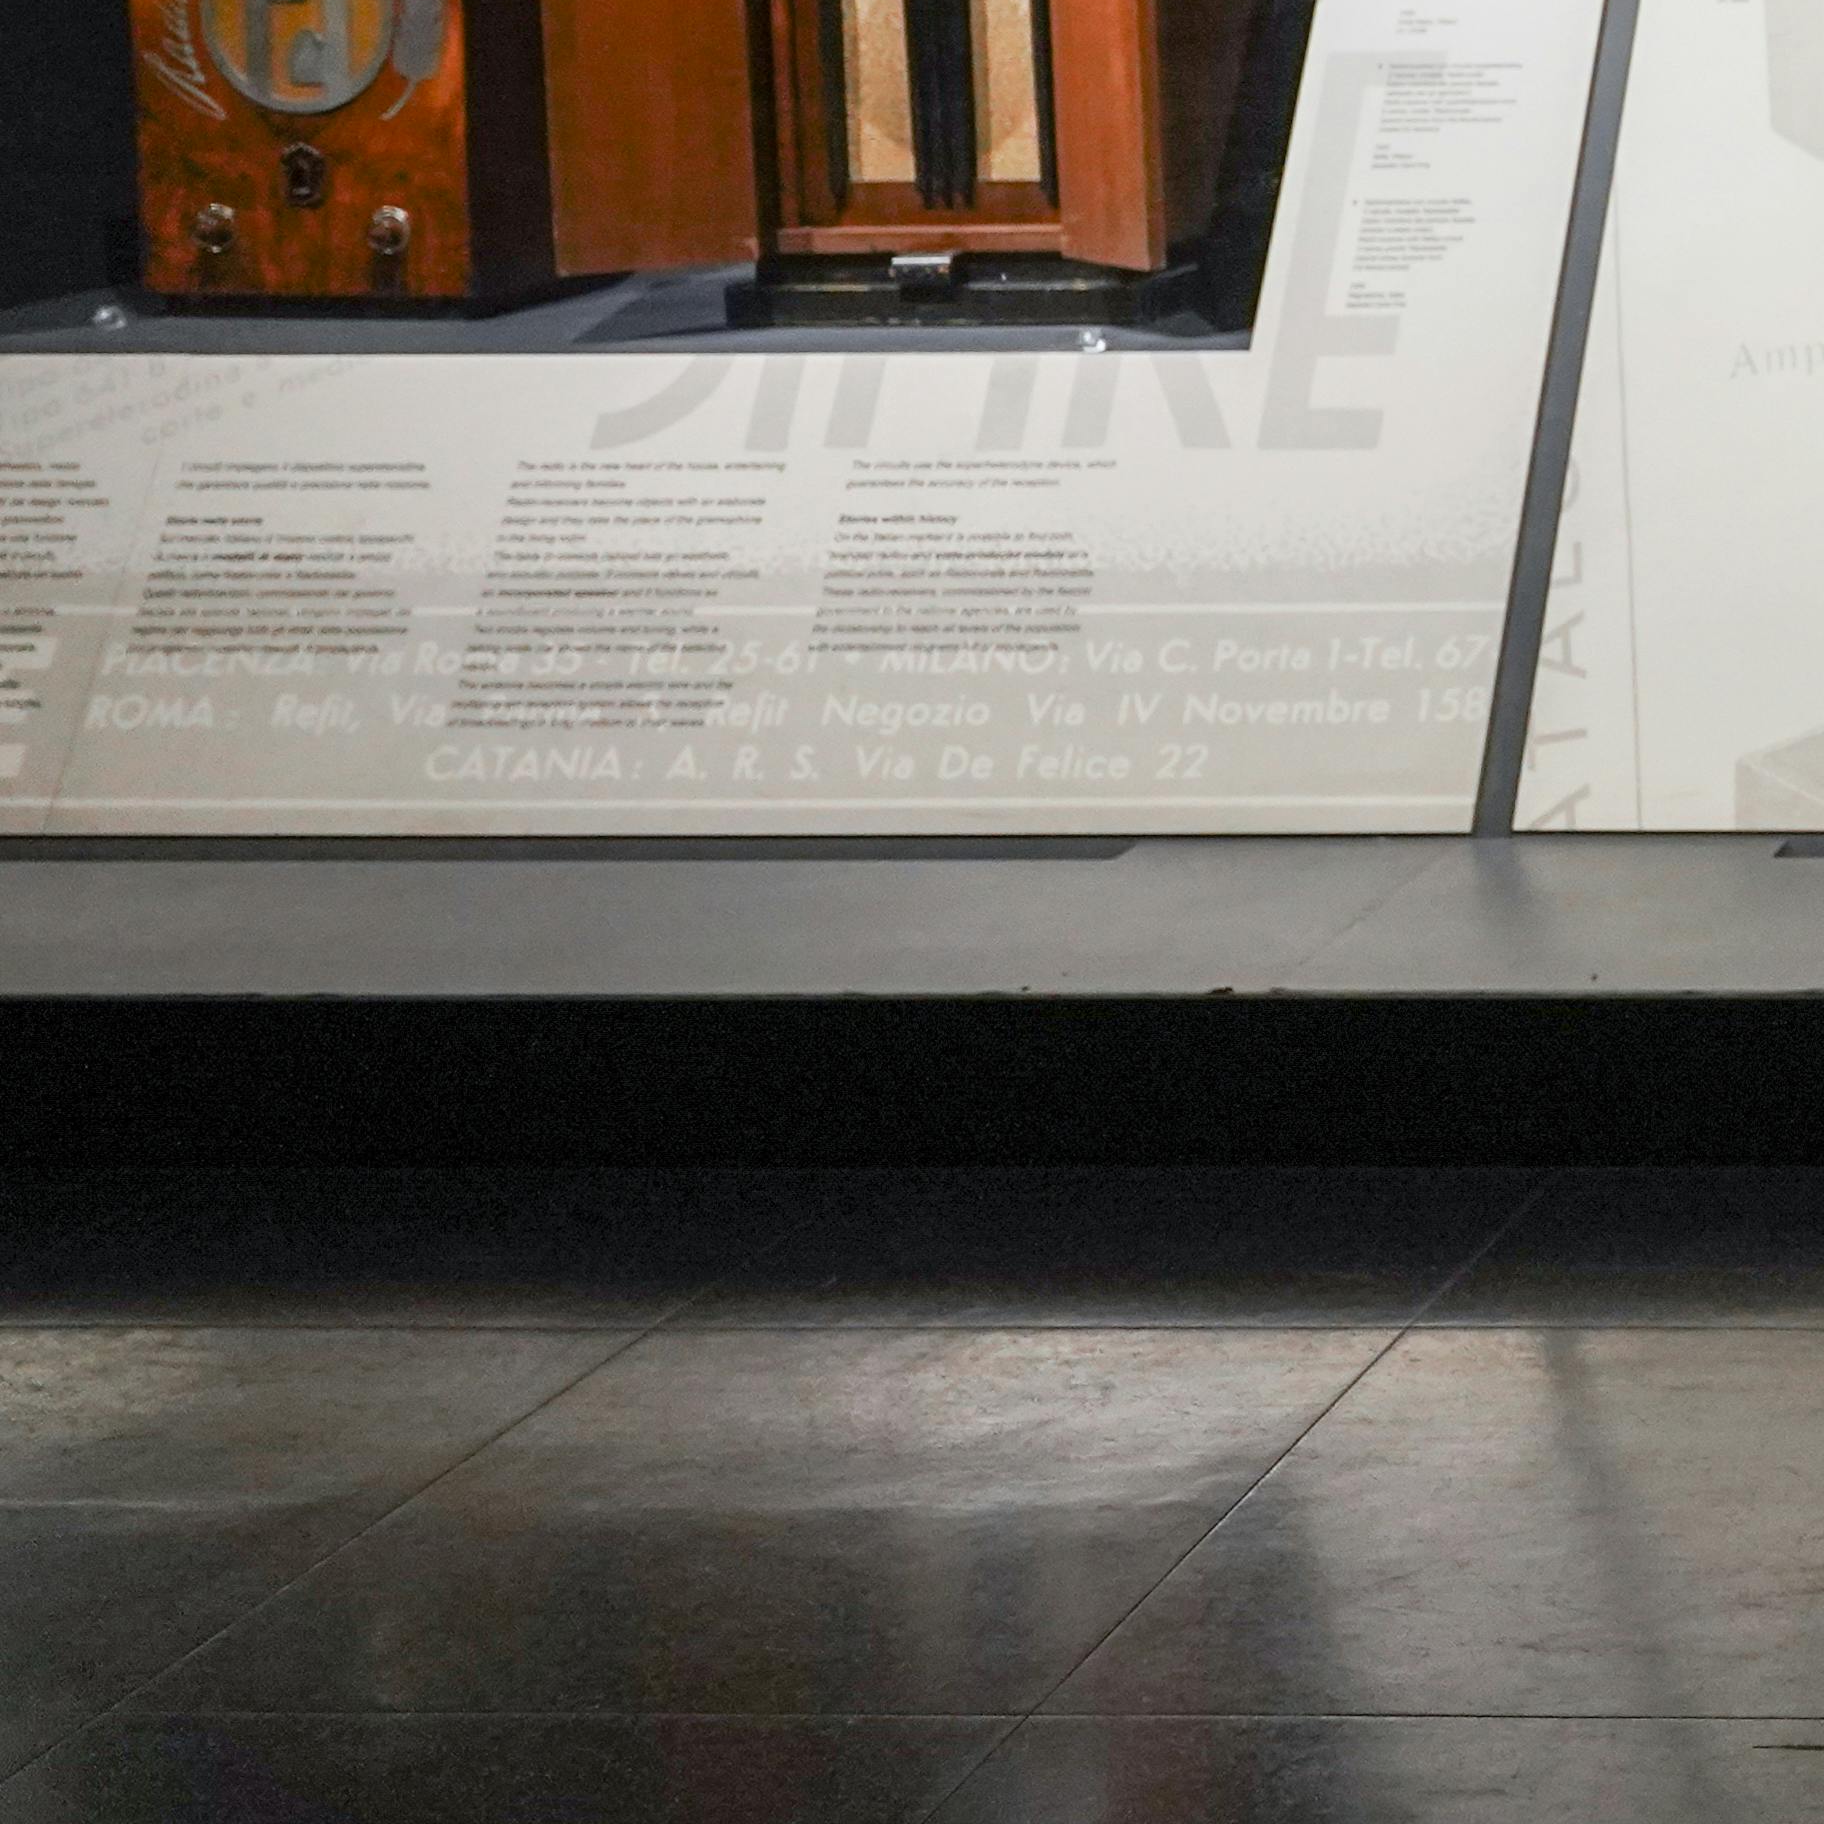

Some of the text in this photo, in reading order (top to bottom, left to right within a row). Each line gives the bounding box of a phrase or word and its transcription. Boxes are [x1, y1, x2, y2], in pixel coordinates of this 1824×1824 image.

[1085, 637, 1144, 674] Via
[1157, 637, 1199, 673] C.
[1213, 636, 1311, 673] Porta
[389, 691, 447, 729] Via
[822, 689, 992, 737] Negozio
[1026, 690, 1086, 727] Via
[1117, 689, 1162, 727] IV
[1183, 687, 1391, 726] Novembre
[425, 743, 644, 781] CATANIA:
[856, 742, 916, 779] Via
[939, 742, 995, 778] De
[1017, 741, 1132, 779] Felice
[1156, 742, 1211, 778] 22
